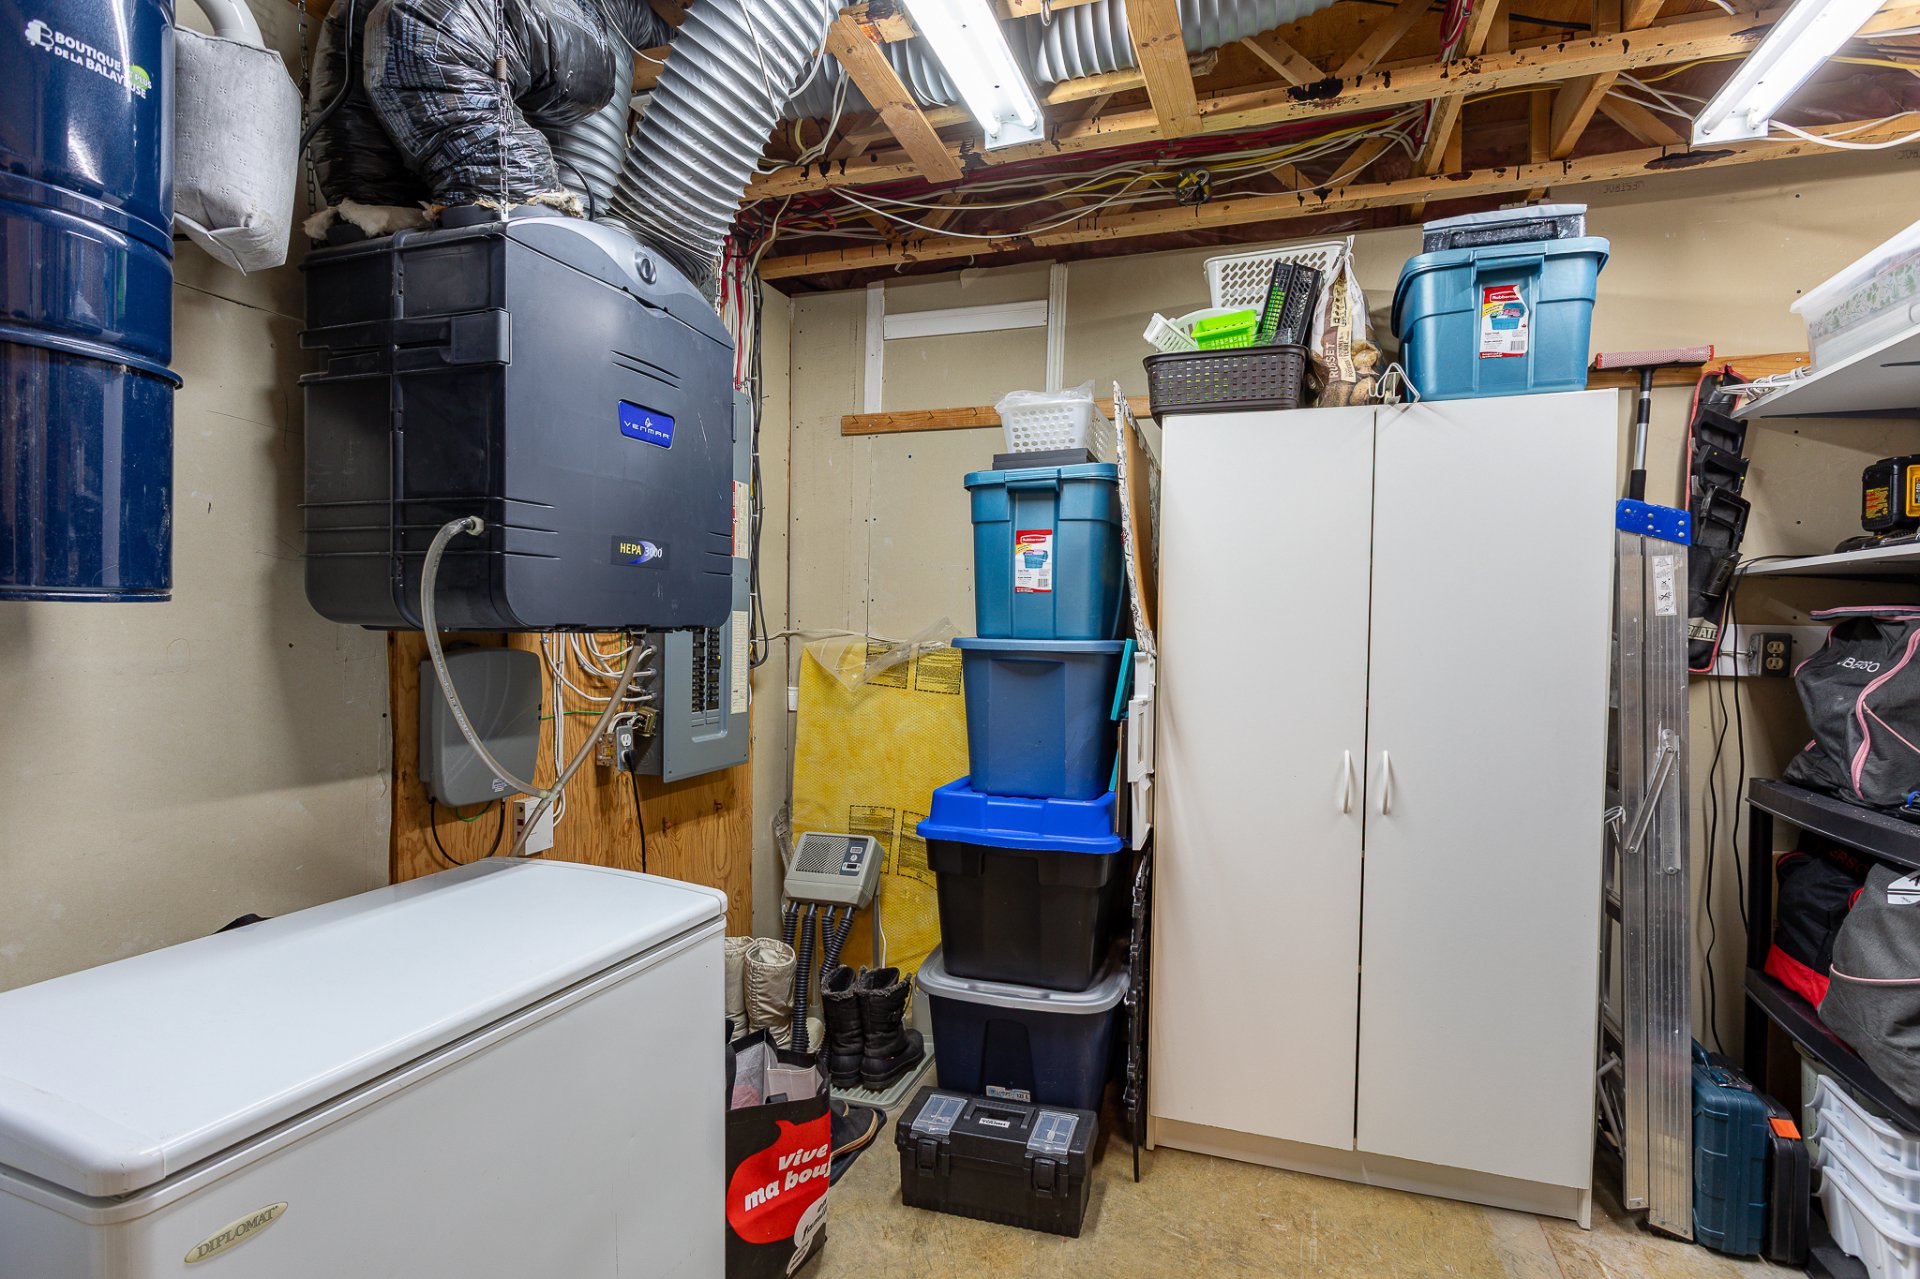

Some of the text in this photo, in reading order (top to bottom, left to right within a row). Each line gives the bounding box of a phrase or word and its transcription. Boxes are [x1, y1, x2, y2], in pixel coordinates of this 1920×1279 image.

[54, 31, 121, 72] BOUTIQUE
[54, 46, 69, 60] DE
[70, 52, 84, 67] LA
[1324, 342, 1340, 379] RUSSET
[623, 420, 670, 440] VENMAR
[619, 542, 642, 556] HEPA
[778, 1143, 829, 1172] Vive
[744, 1179, 780, 1213] ma
[196, 1207, 275, 1259] DIPLOMAT
